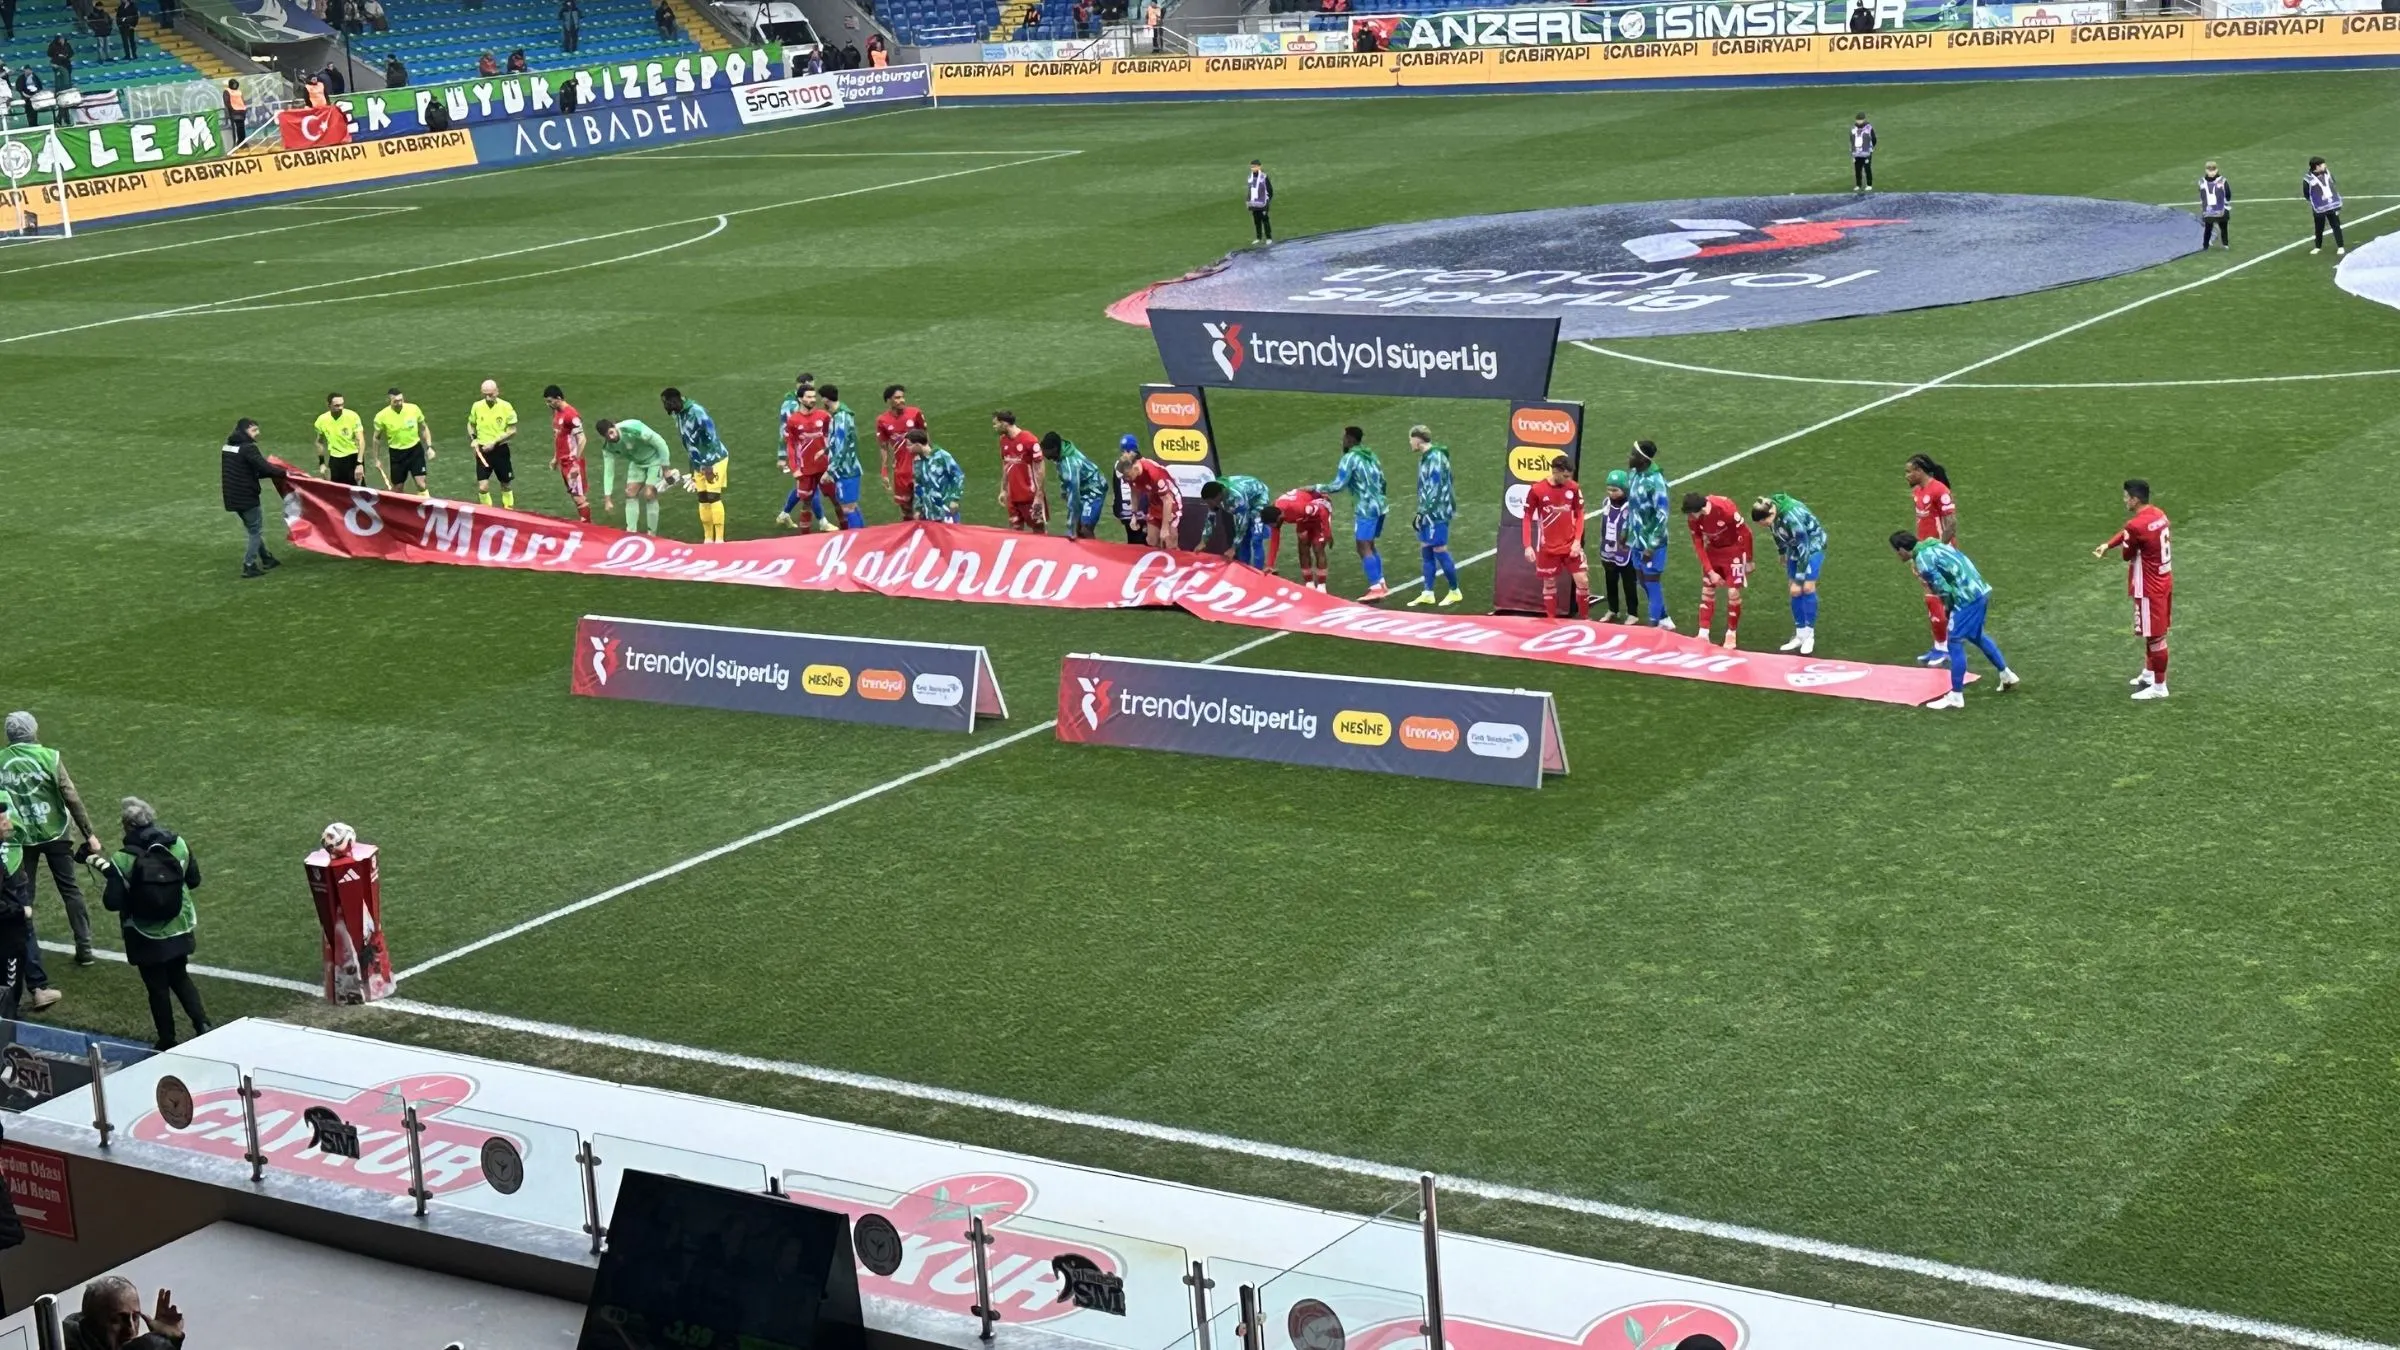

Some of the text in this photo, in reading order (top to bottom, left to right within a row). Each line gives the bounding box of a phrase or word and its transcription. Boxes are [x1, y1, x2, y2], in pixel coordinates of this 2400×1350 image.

[838, 69, 925, 87] Magdeburger
[839, 86, 884, 100] Sigorta
[37, 116, 216, 174] ALEM
[1322, 264, 1880, 290] trendyol
[1250, 332, 1382, 374] trendyol
[1151, 402, 1196, 417] trendyol
[1518, 418, 1570, 435] trendyol
[343, 486, 385, 537] 8
[417, 499, 584, 565] Mart
[587, 535, 797, 582] Dünya
[803, 527, 1098, 601] Kadınlar
[625, 647, 714, 682] trendyol
[862, 676, 902, 692] trendyol
[1120, 688, 1226, 726] trendyol
[1406, 724, 1455, 743] trendyol
[30, 1181, 61, 1203] Room
